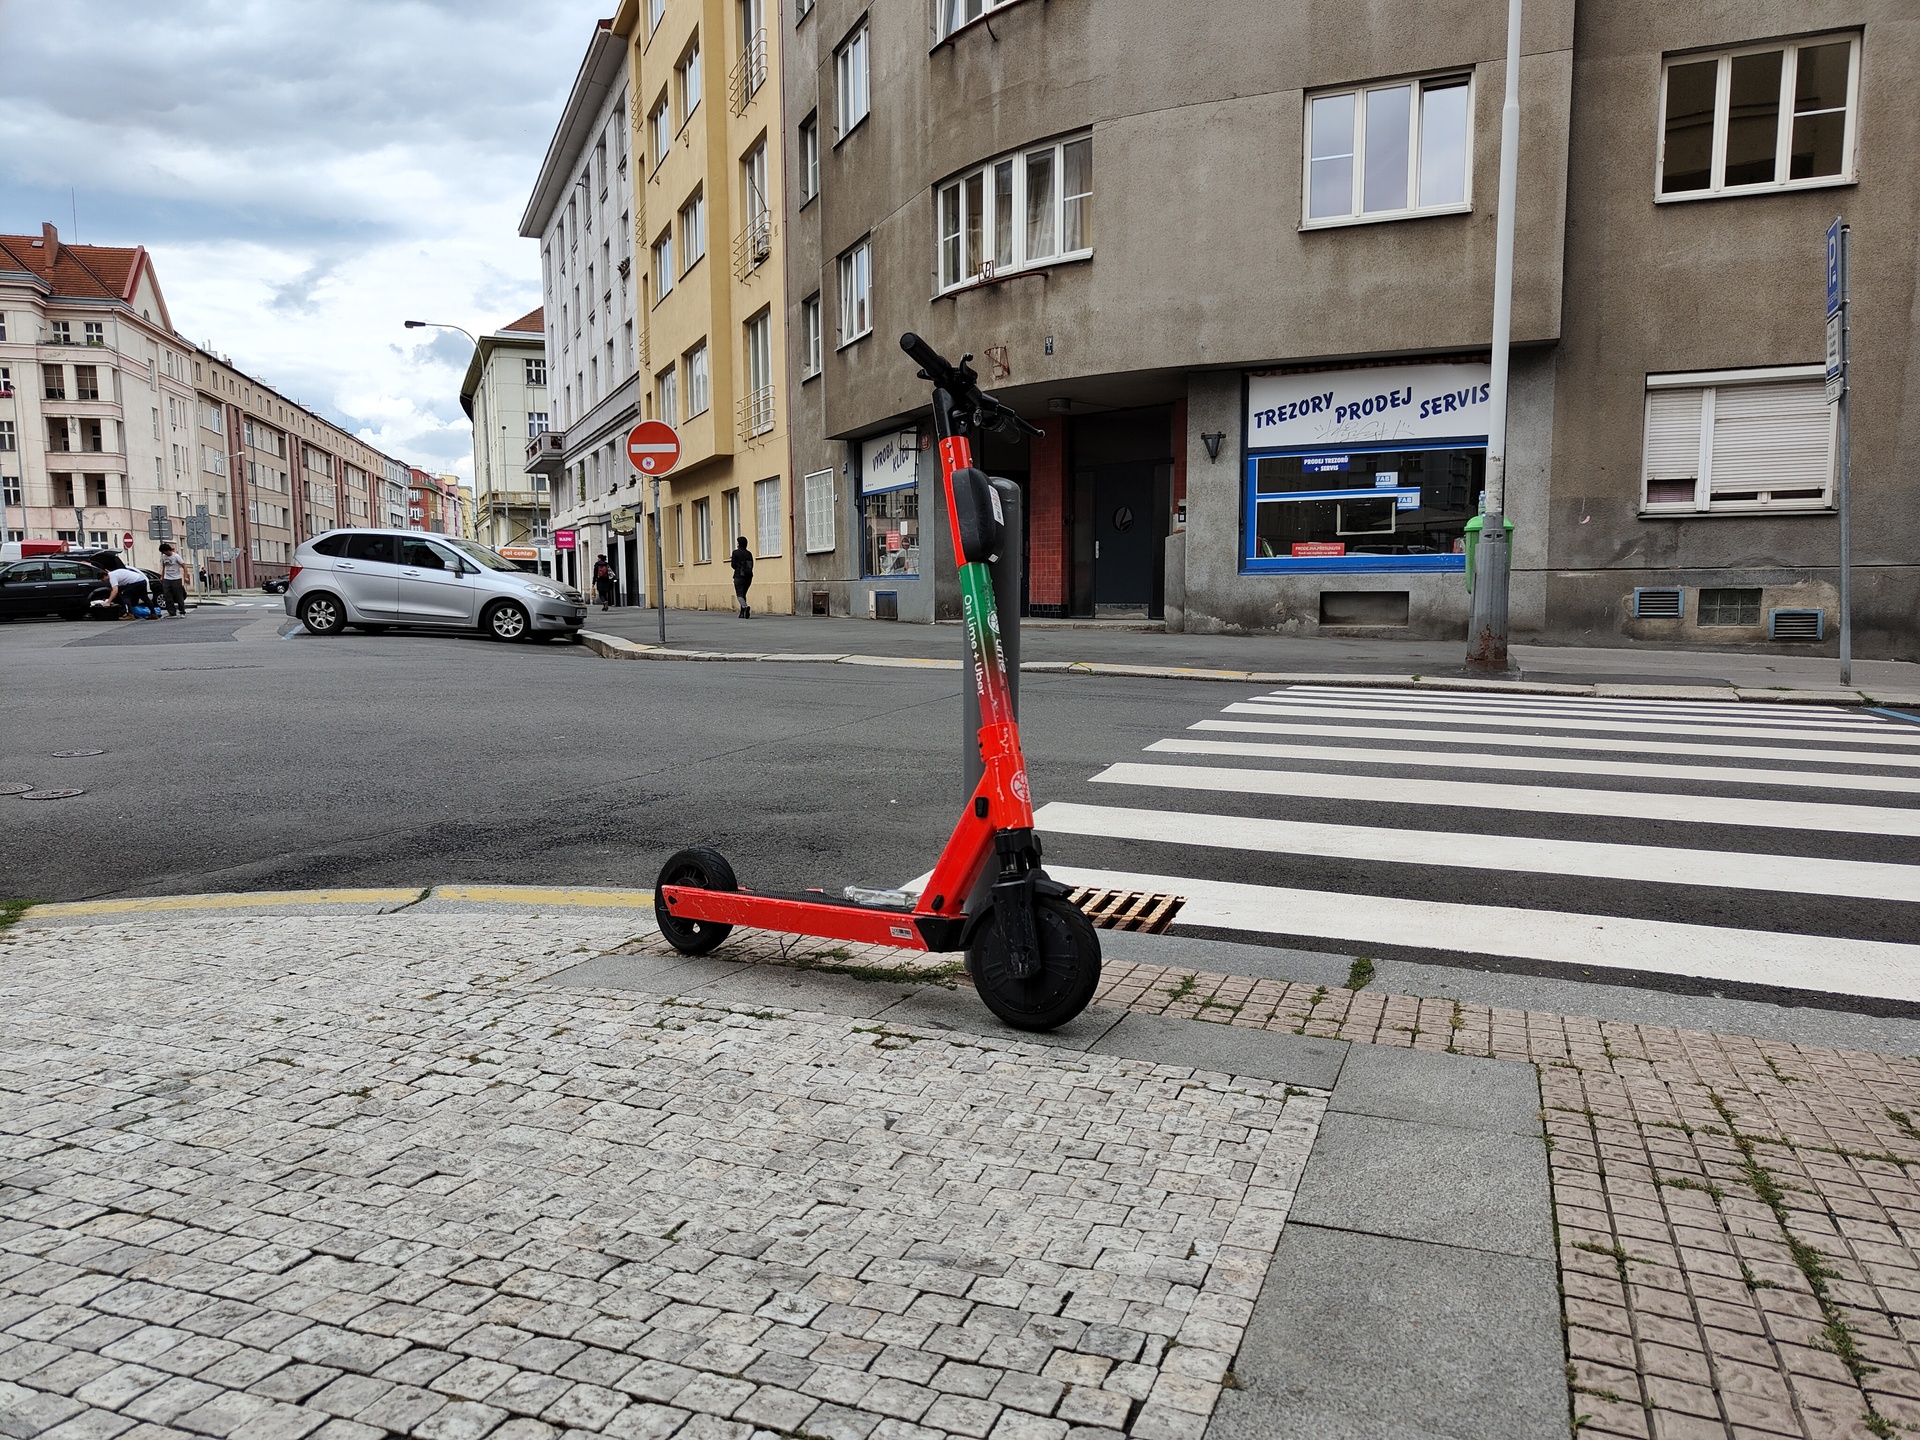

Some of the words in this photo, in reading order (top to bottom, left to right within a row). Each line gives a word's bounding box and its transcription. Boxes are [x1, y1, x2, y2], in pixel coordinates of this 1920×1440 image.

[1828, 235, 1837, 288] P
[1253, 391, 1334, 429] TREZORY
[1335, 387, 1412, 424] PRODEJ
[1419, 382, 1490, 420] SERVIS
[872, 440, 894, 473] VÝROBA
[964, 595, 973, 615] On
[967, 616, 978, 650] Lime
[974, 661, 985, 696] Uber
